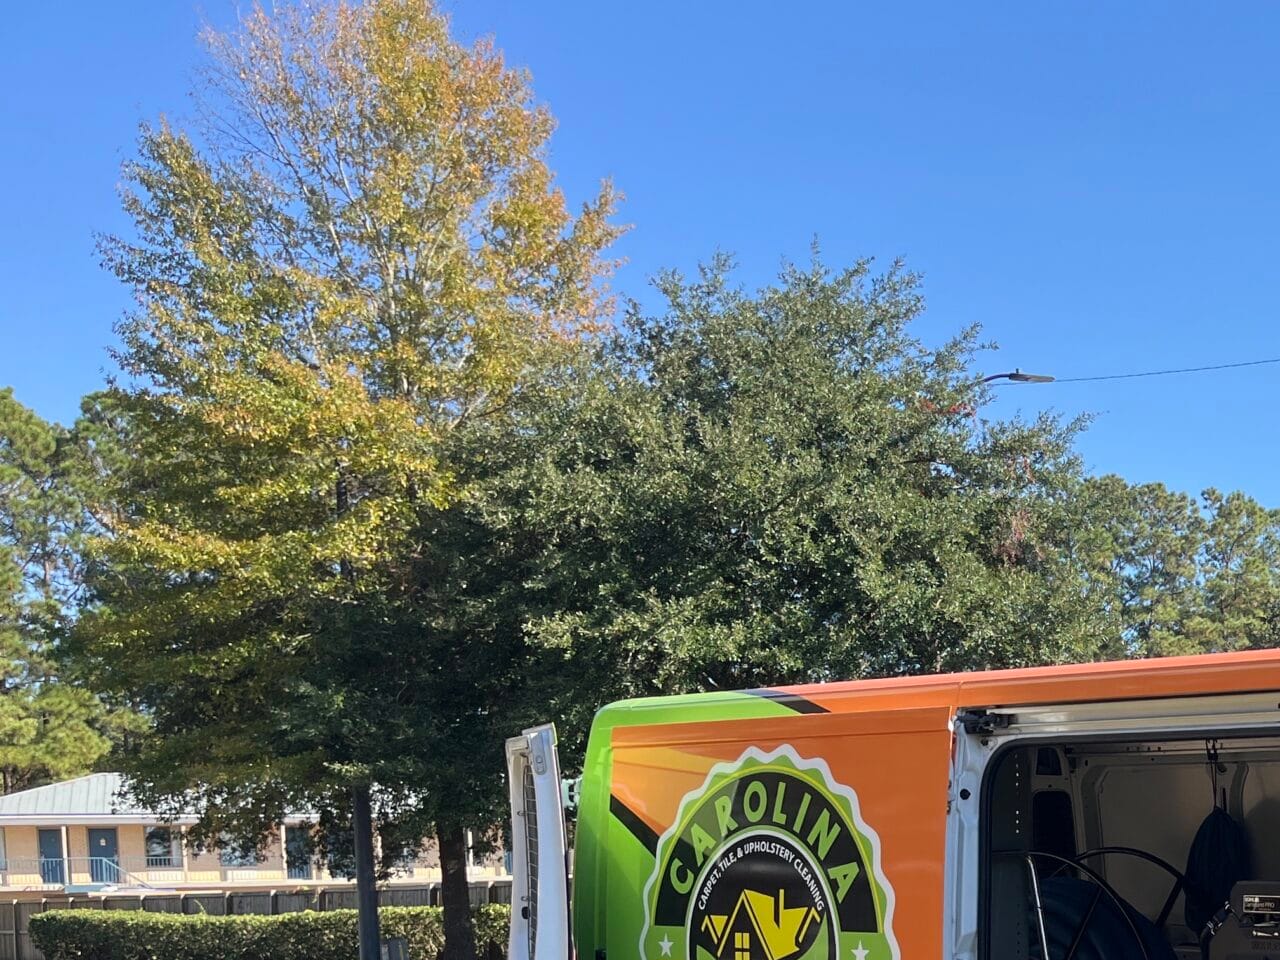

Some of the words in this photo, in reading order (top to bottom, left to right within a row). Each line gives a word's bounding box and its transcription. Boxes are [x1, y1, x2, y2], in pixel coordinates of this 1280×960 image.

[669, 780, 860, 904] CAROLINA
[698, 868, 722, 910] CARPET,
[718, 852, 738, 872] TILE,
[737, 847, 744, 858] &
[744, 840, 795, 863] UPHOLSTERY
[793, 858, 825, 912] CLEANING
